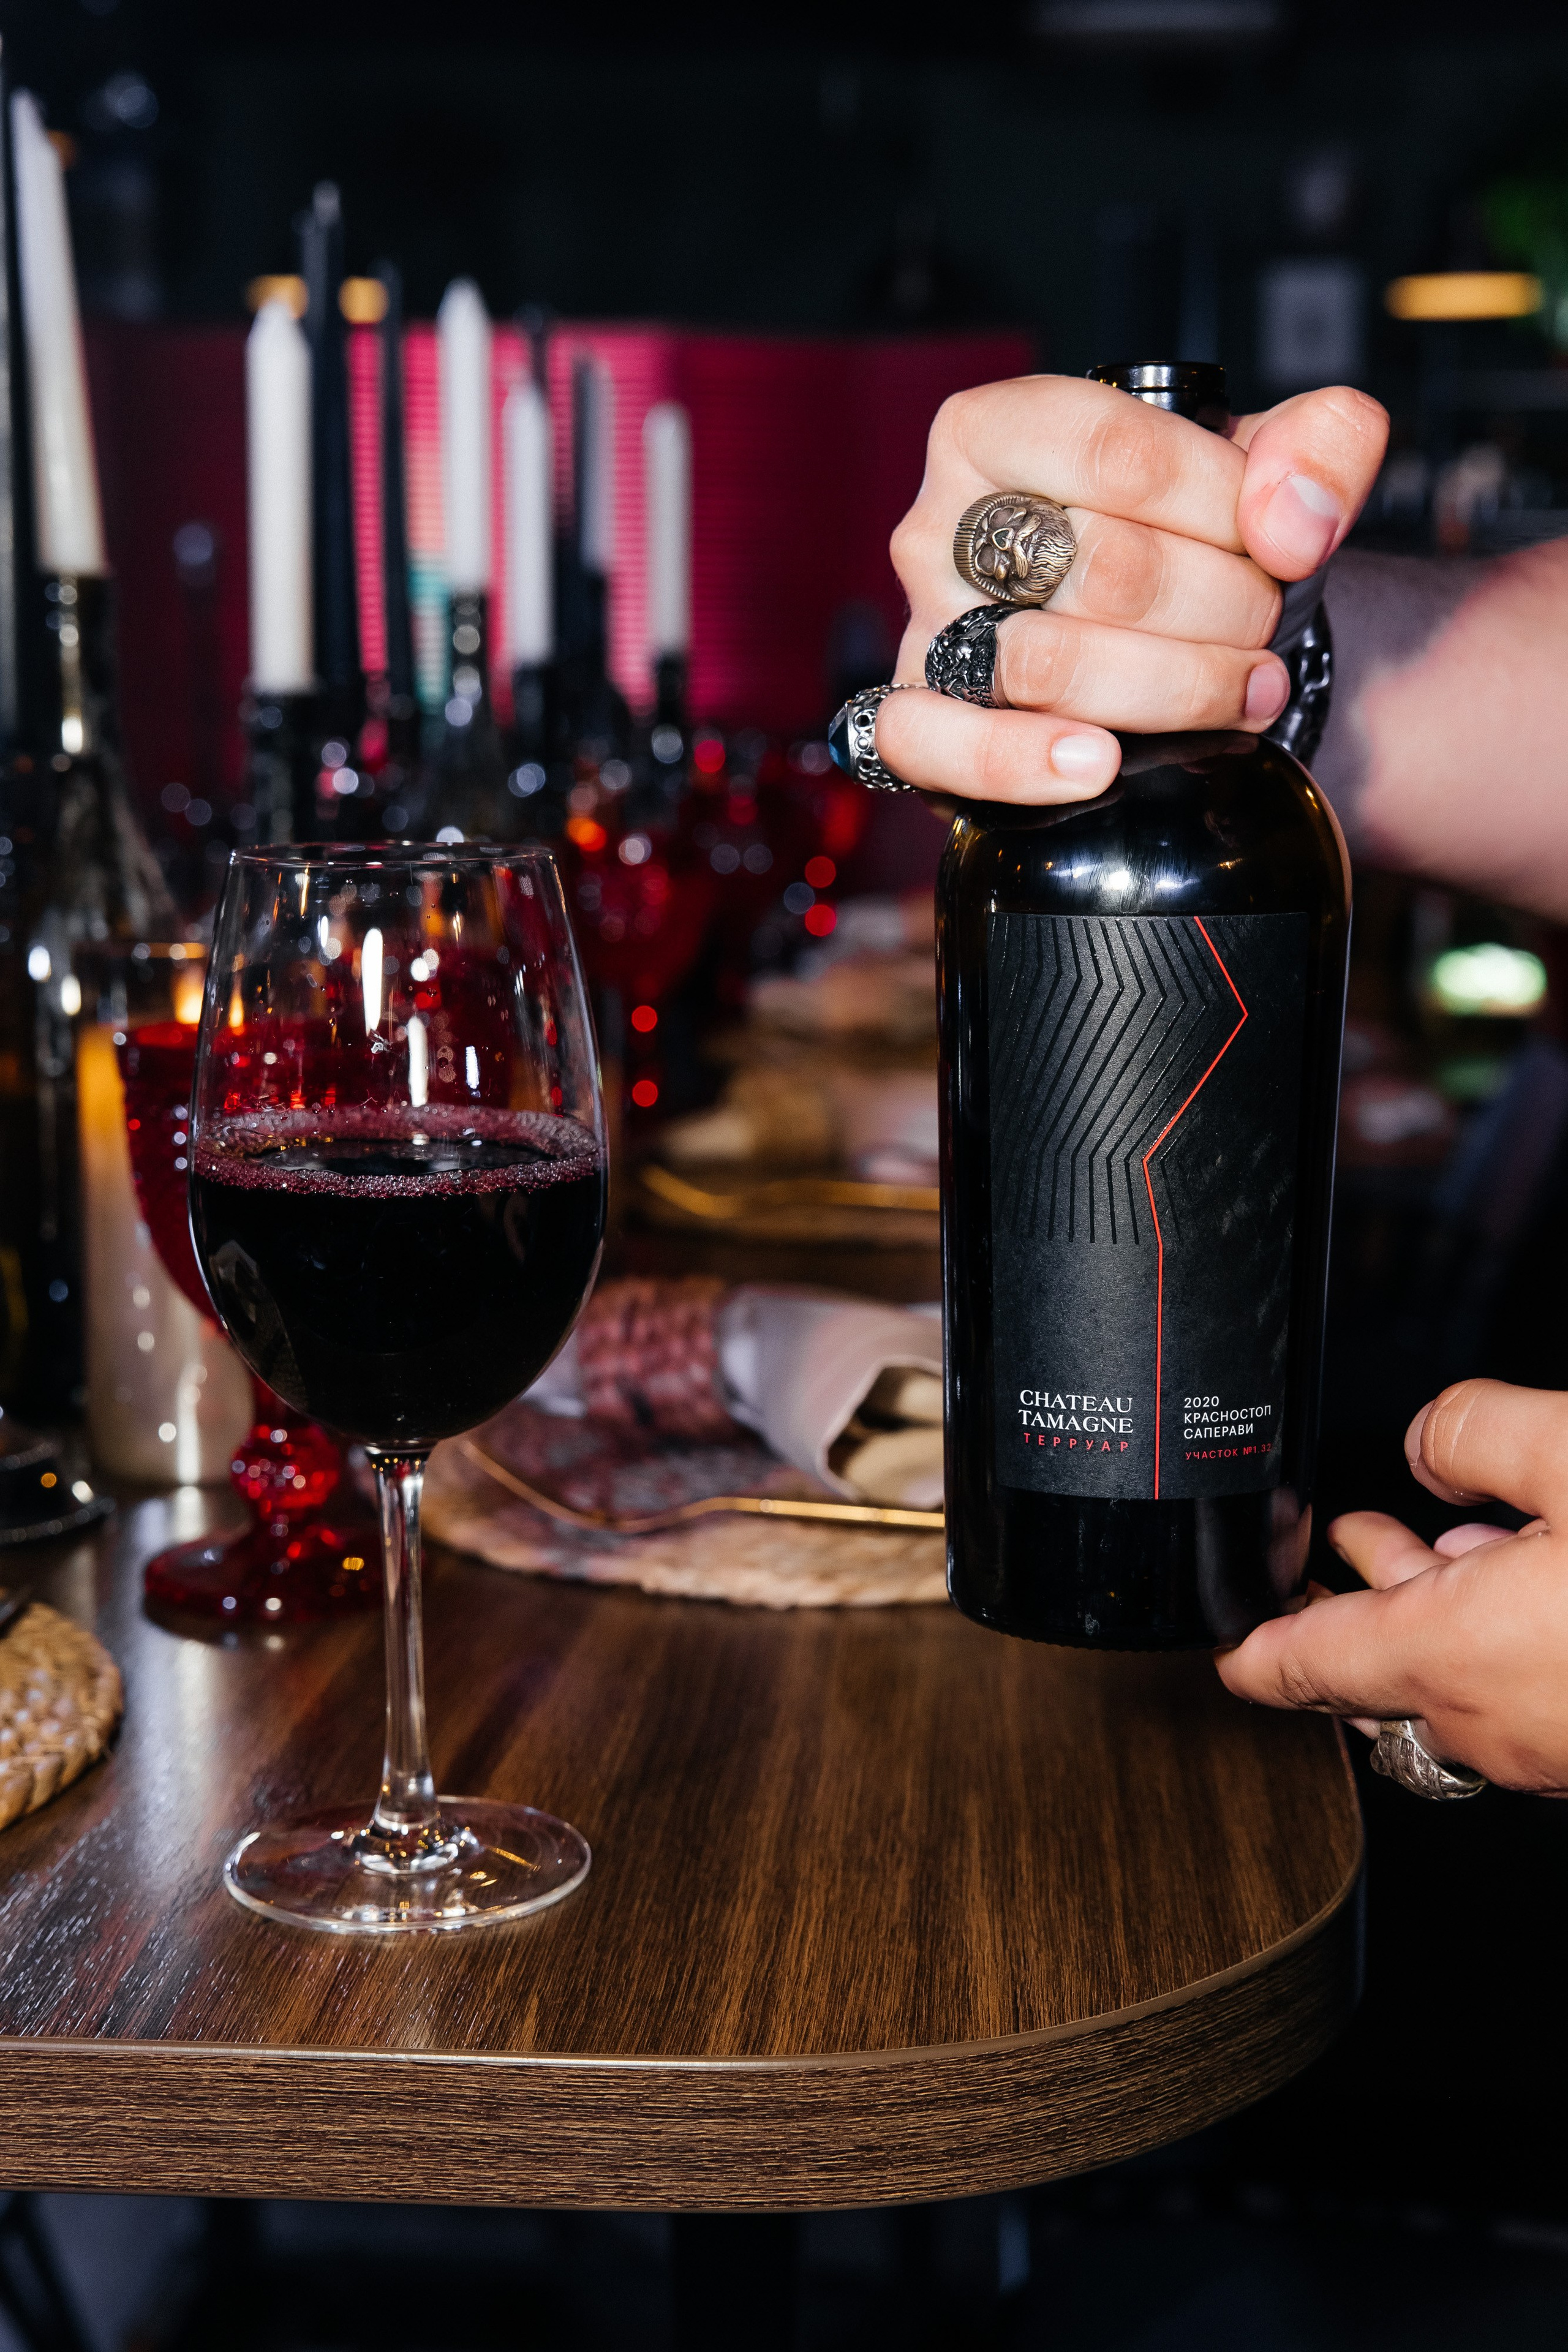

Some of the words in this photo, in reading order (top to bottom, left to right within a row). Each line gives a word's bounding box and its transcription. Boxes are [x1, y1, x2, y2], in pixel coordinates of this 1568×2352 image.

[1020, 1389, 1133, 1413] CHATEAU
[1184, 1396, 1219, 1408] 2020
[1018, 1409, 1134, 1433] TAMAGNE
[1184, 1405, 1272, 1424] КРАСНОСТОП
[1183, 1423, 1254, 1439] САПЕРАВИ
[1023, 1433, 1129, 1452] ТЕРРУАР
[1185, 1448, 1238, 1460] УЧАСТОК
